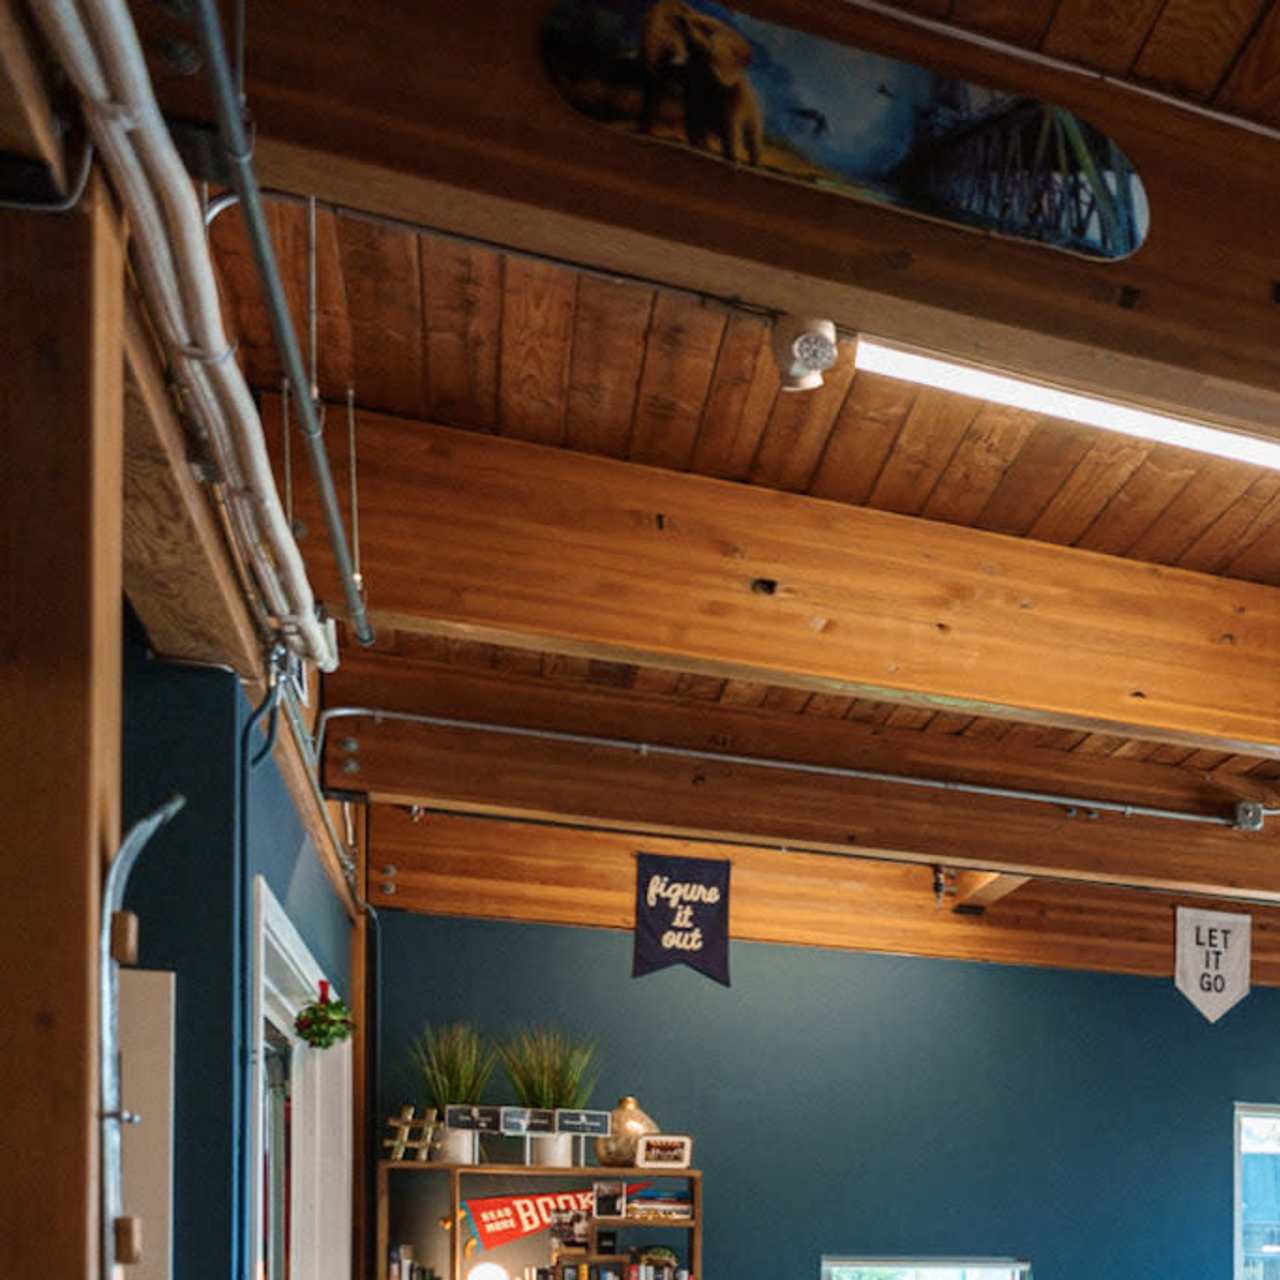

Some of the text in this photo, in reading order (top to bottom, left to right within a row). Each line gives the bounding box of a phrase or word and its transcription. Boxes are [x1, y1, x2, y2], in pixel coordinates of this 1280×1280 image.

[646, 875, 720, 908] figure
[671, 905, 694, 928] it
[661, 928, 704, 951] out
[1195, 926, 1232, 949] LET
[1205, 949, 1223, 970] IT
[1200, 972, 1226, 993] GO
